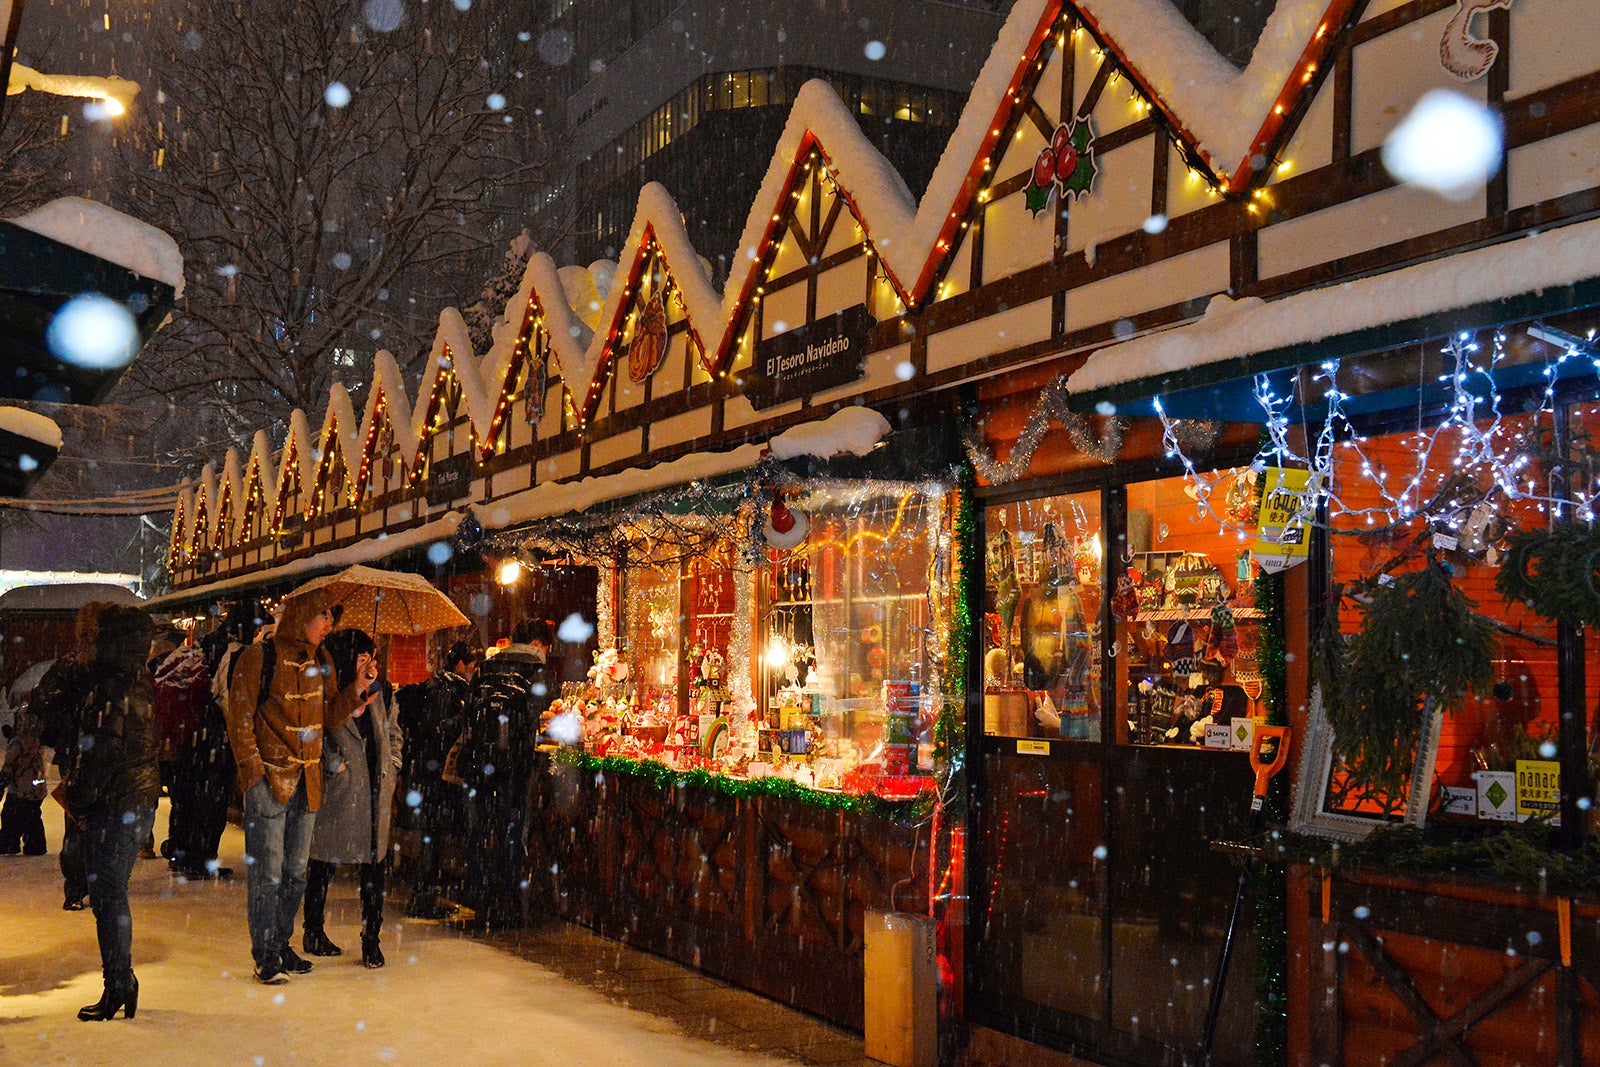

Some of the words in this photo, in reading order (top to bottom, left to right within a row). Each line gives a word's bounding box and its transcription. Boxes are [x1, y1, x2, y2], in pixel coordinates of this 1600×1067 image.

[766, 358, 775, 377] El
[775, 352, 804, 374] Tesoro
[806, 334, 850, 363] Navideño
